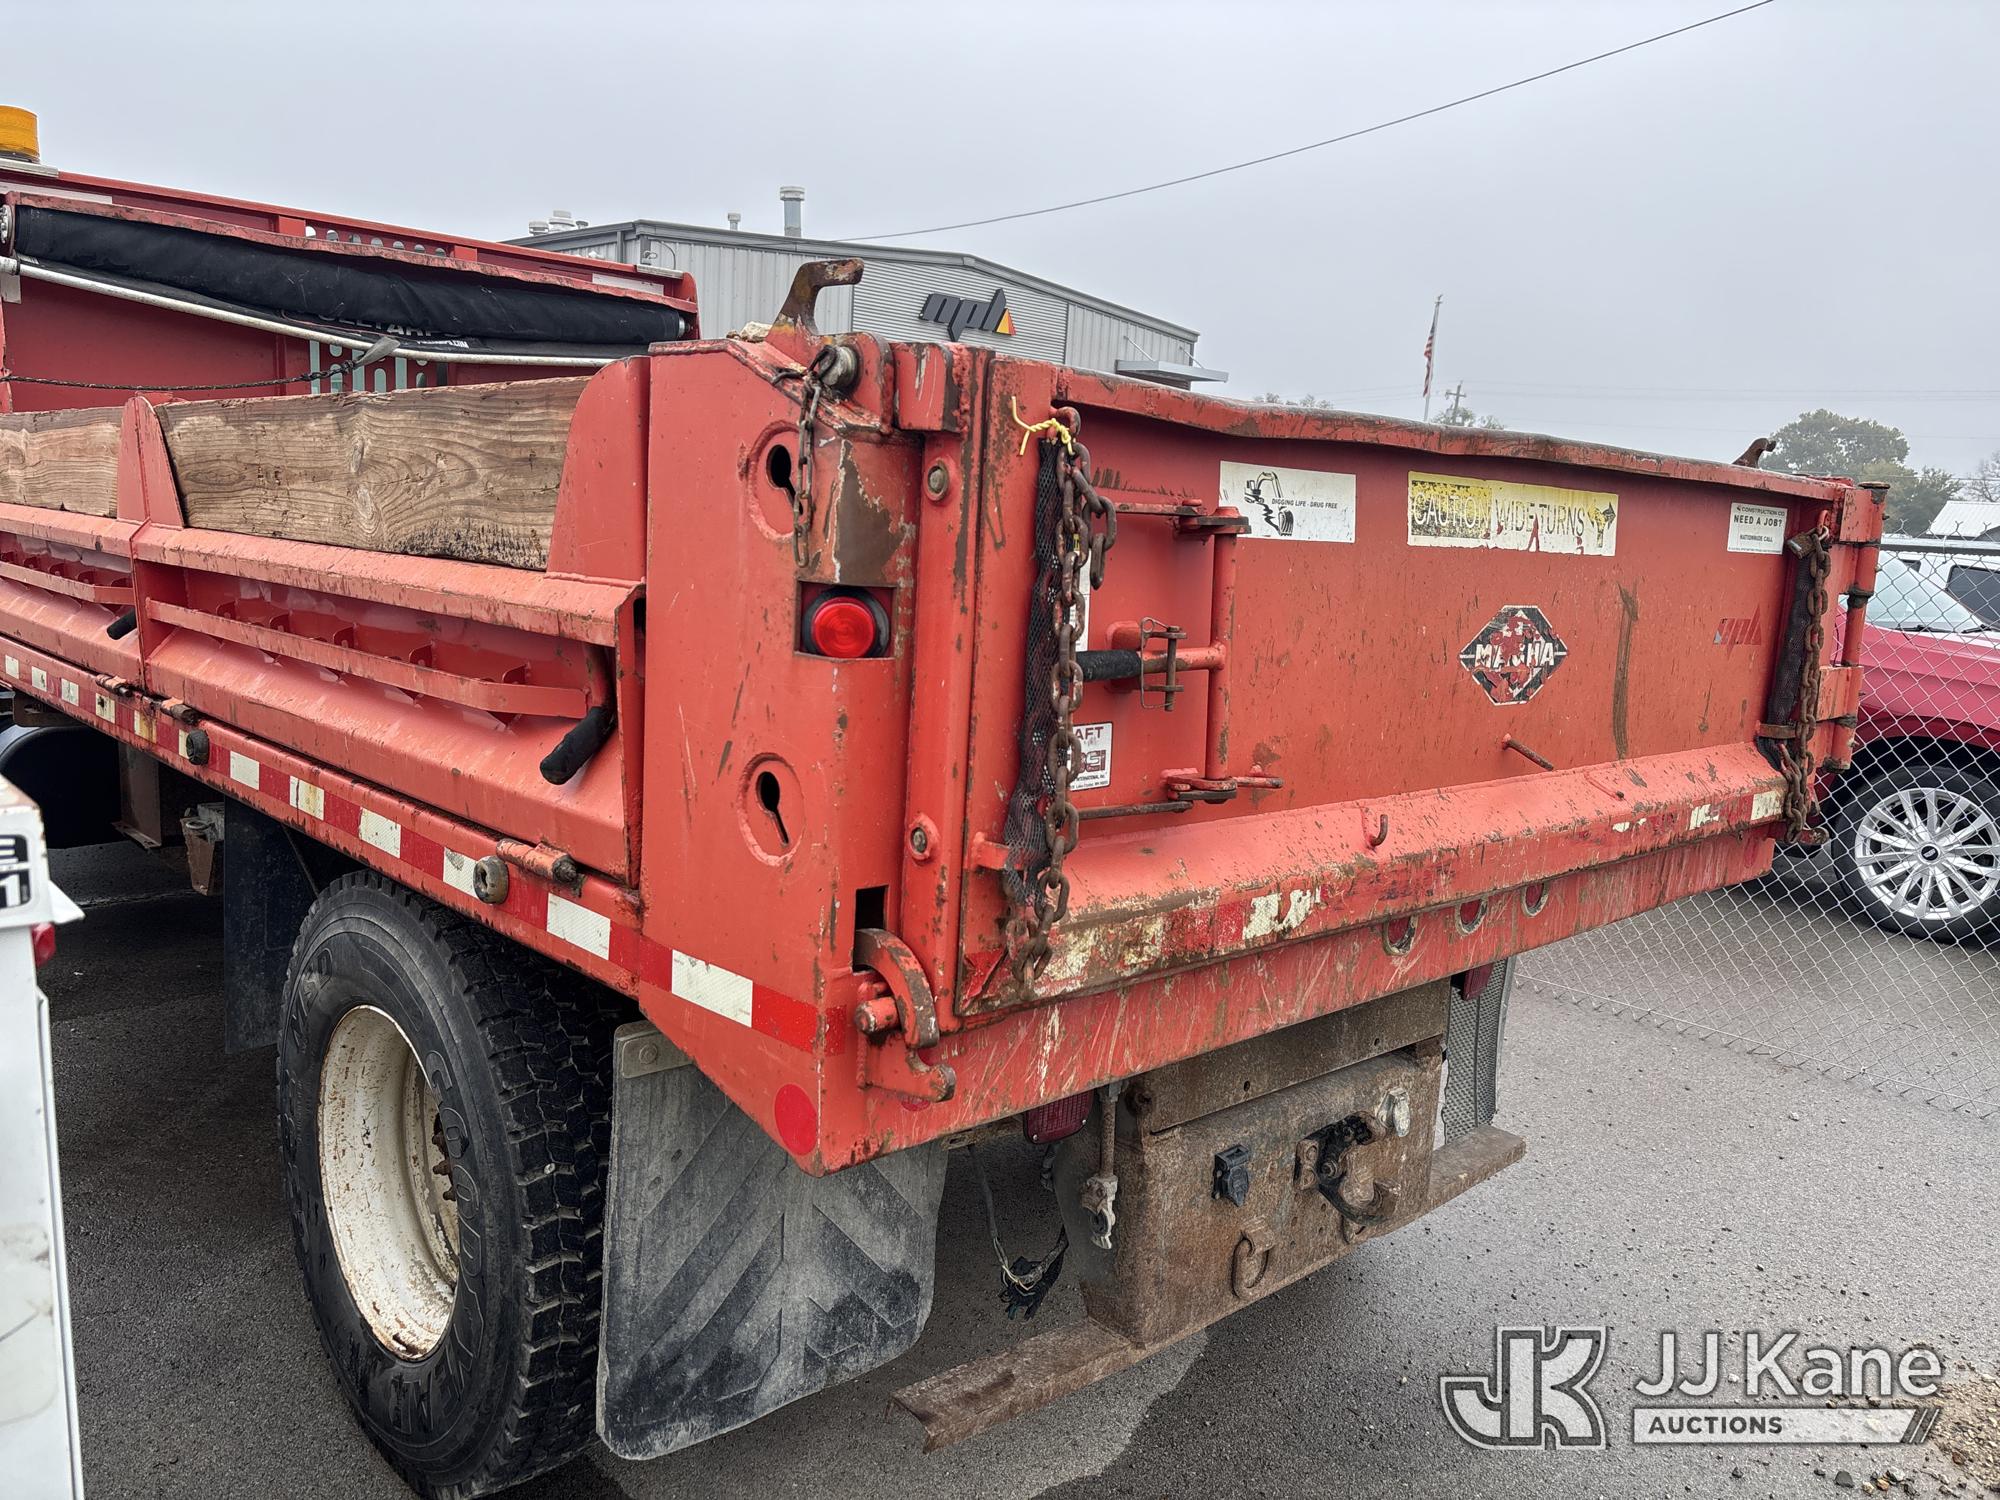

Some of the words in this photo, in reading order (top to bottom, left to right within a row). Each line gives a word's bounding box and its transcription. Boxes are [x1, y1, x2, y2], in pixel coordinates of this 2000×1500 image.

[1272, 498, 1294, 506] DIGGING
[1412, 492, 1489, 531] CAUTION
[1494, 499, 1535, 533] WIDE
[1538, 503, 1586, 537] TURNS
[1733, 514, 1754, 525] NEED
[1756, 517, 1761, 525] A
[1763, 518, 1782, 527] JOB?
